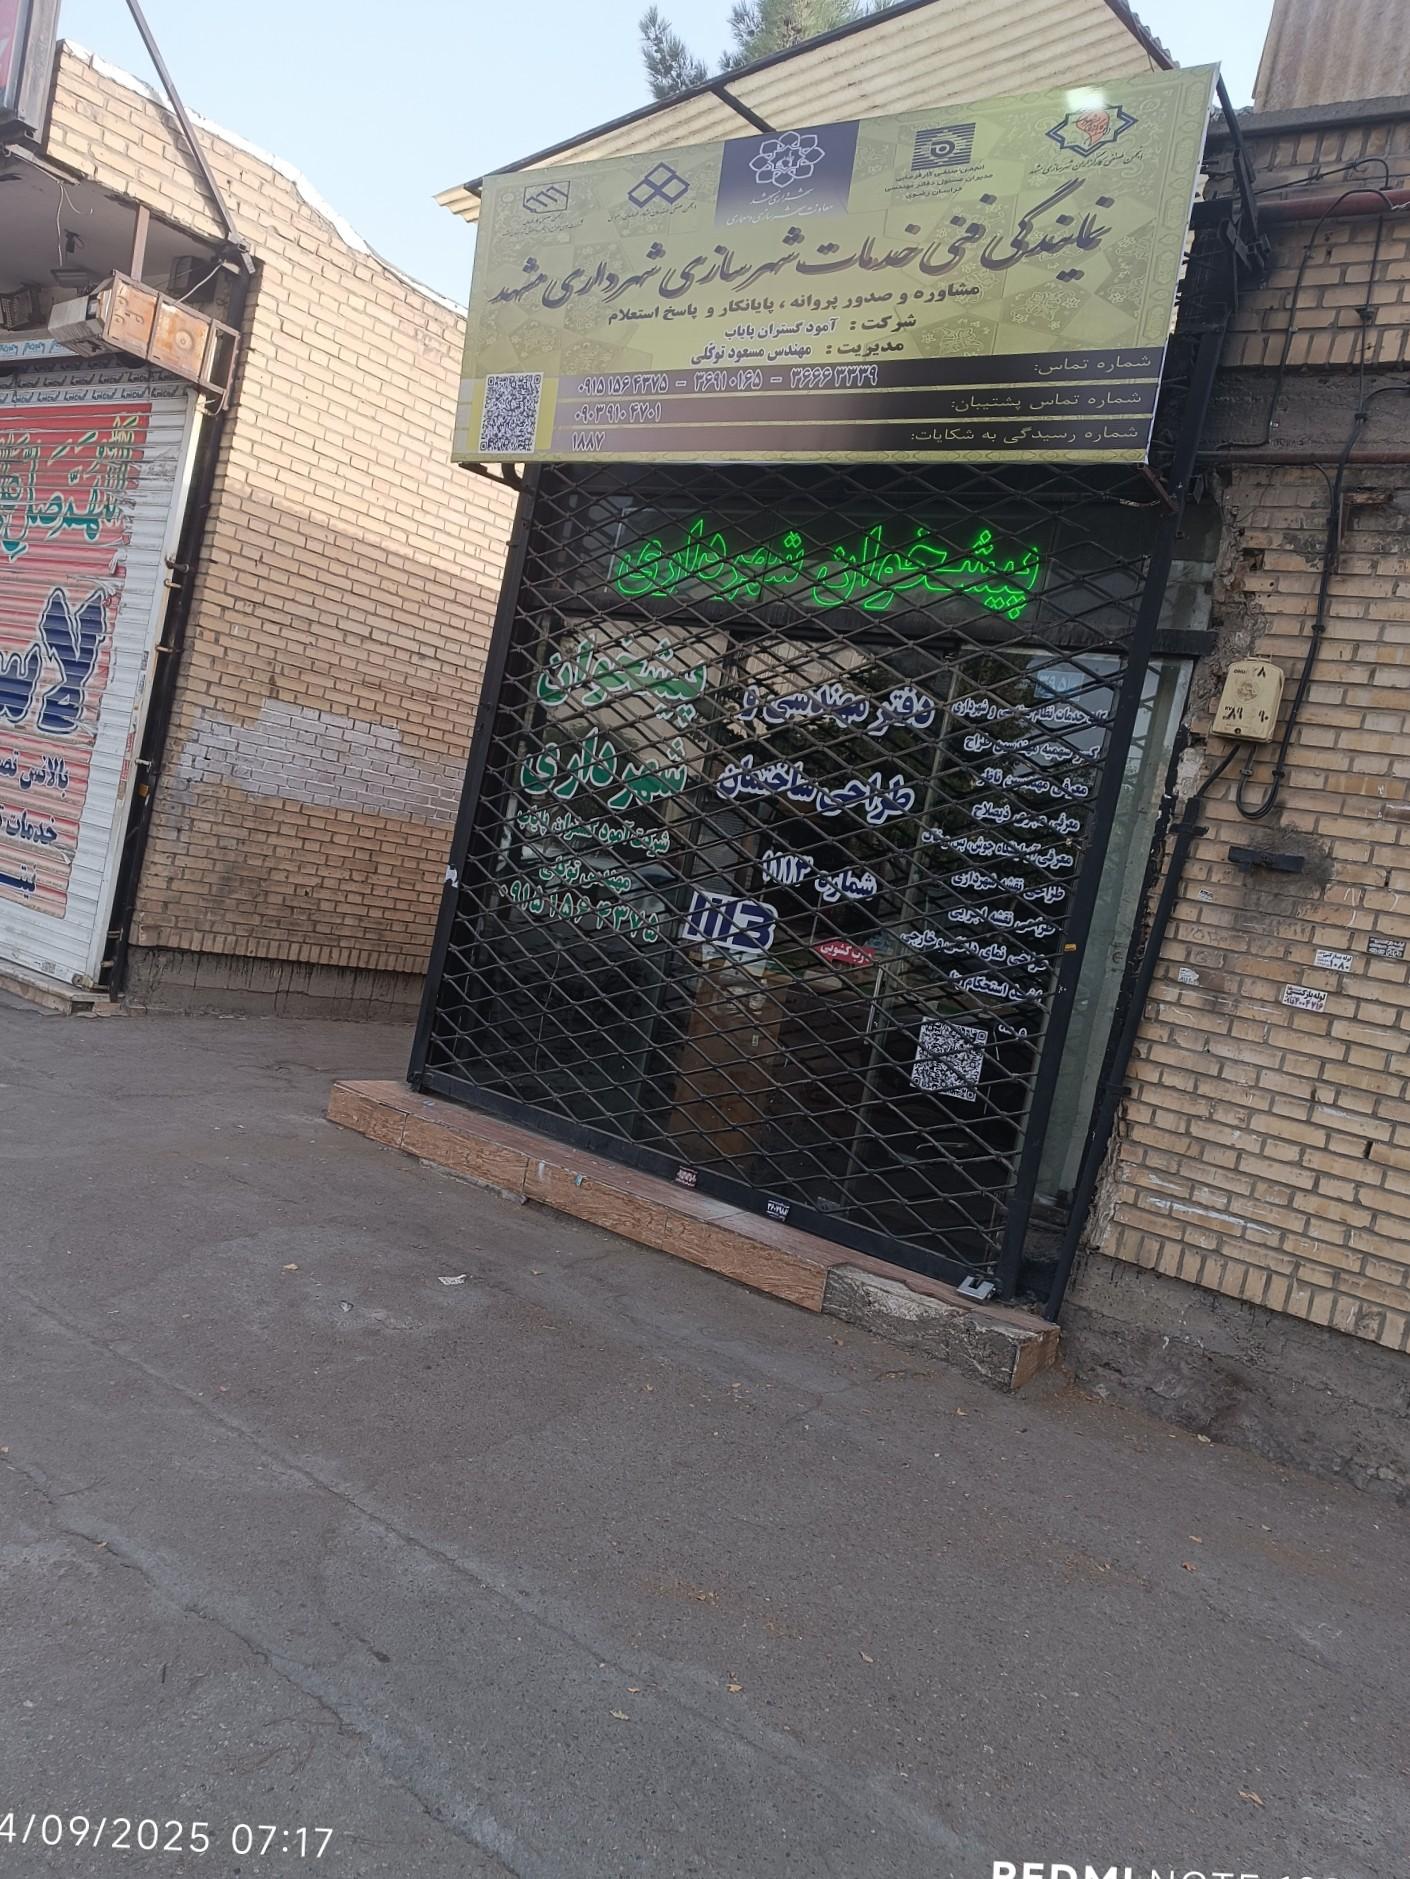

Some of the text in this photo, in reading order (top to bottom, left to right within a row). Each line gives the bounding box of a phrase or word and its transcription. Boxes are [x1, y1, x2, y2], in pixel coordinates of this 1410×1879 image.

[488, 177, 1116, 309] نمایندگی فنی خدمات شهرسازی شهرداری مشهد
[789, 294, 838, 310] پروانه
[842, 292, 893, 309] صدور
[896, 292, 909, 305] و
[913, 282, 980, 303] مشاوره
[608, 305, 660, 326] استعلام
[662, 303, 698, 321] پاسخ
[704, 306, 714, 318] و
[717, 297, 774, 318] پایانکار
[805, 317, 838, 336] آمود
[861, 313, 917, 332] شرکت
[728, 346, 765, 363] مسعود
[767, 343, 812, 362] مهندس
[837, 342, 904, 357] مدیریت
[1096, 354, 1151, 373] شماره
[1029, 393, 1080, 410] تماس
[1087, 391, 1142, 408] شماره
[571, 431, 606, 452] ۱۸۸۷
[982, 431, 997, 442] به
[1003, 426, 1076, 444] رسیدگی
[1084, 425, 1139, 442] شماره
[615, 518, 1039, 620] پیشخوان شهرداری
[762, 682, 870, 729] مهندسی
[864, 685, 936, 737] دفتر
[951, 697, 989, 718] شهرداری
[1054, 706, 1088, 724] خدمات
[520, 726, 688, 810] شهرداری
[715, 753, 916, 825] طراحی ساختمان
[5, 807, 58, 845] خدمات
[1036, 847, 1074, 870] معرفی
[951, 871, 998, 890] شهرداری
[1330, 959, 1349, 970] ۱۰۸۰
